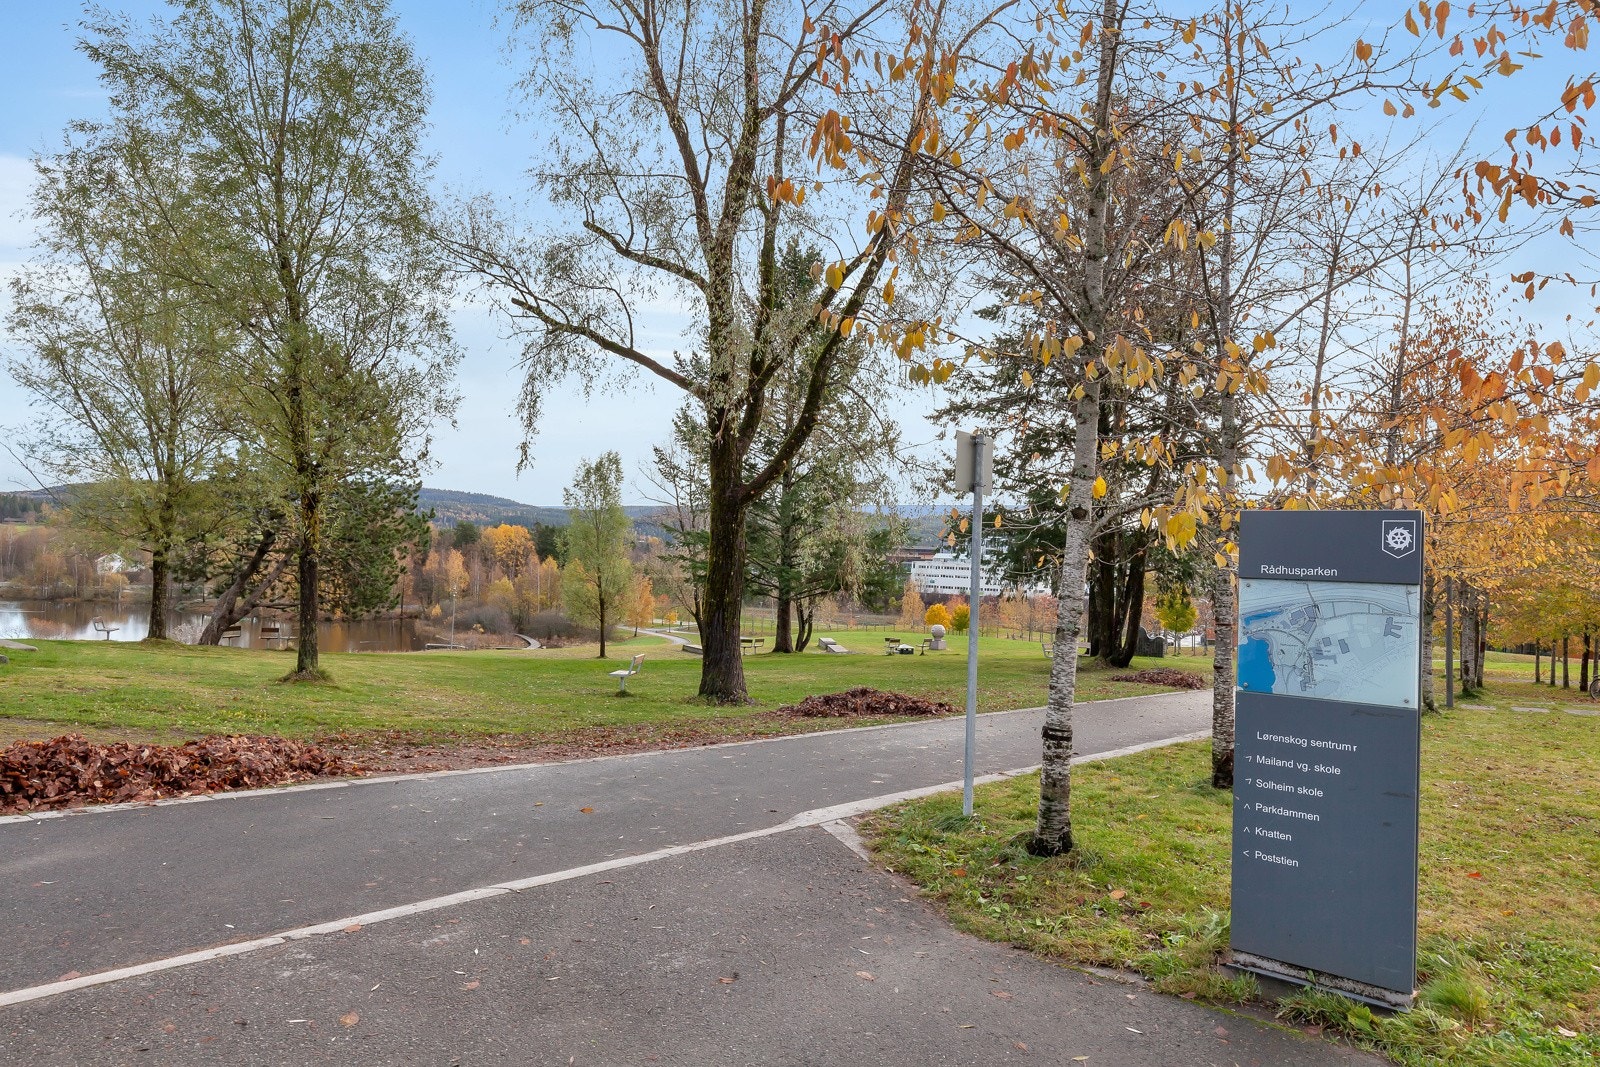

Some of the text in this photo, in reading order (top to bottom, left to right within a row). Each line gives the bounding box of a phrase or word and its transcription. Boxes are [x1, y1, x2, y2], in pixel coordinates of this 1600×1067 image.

[1260, 564, 1338, 577] Rådhusparken
[1257, 731, 1307, 747] Lørenskog
[1256, 755, 1341, 774] Mailand vg. skole
[1255, 779, 1323, 797] Solheim skole
[1255, 803, 1320, 821] Parkdammen
[1255, 827, 1292, 841] Knatten
[1255, 851, 1299, 867] Poststien
